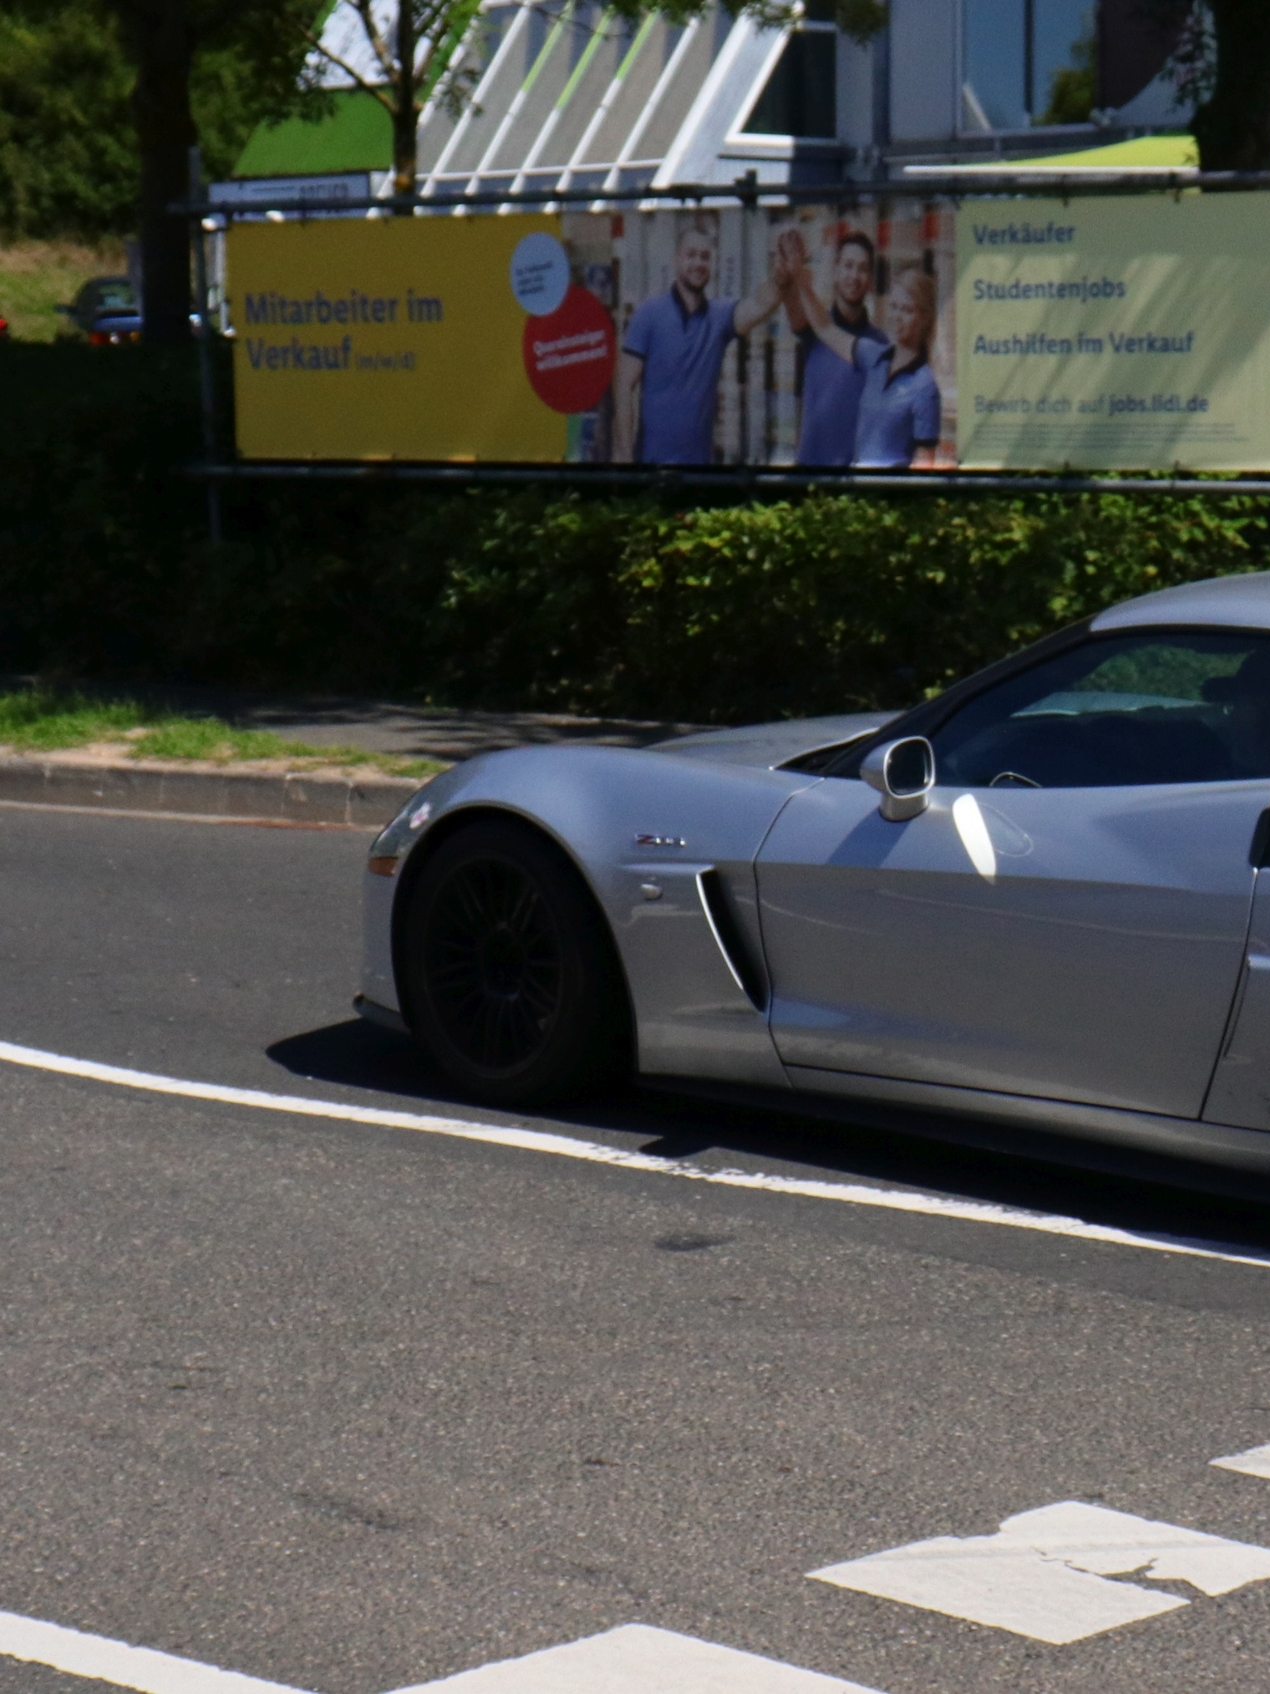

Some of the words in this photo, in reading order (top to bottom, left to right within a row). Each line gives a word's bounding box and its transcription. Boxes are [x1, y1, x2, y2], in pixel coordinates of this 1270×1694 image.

[972, 222, 1075, 245] Verkäufer
[973, 276, 1126, 303] Studentenjobs
[245, 289, 397, 324] Mitarbeiter
[407, 288, 443, 323] im
[247, 336, 352, 371] Verkauf
[973, 332, 1072, 356] Aushilfen
[1077, 330, 1103, 353] im
[1109, 330, 1195, 353] Verkauf
